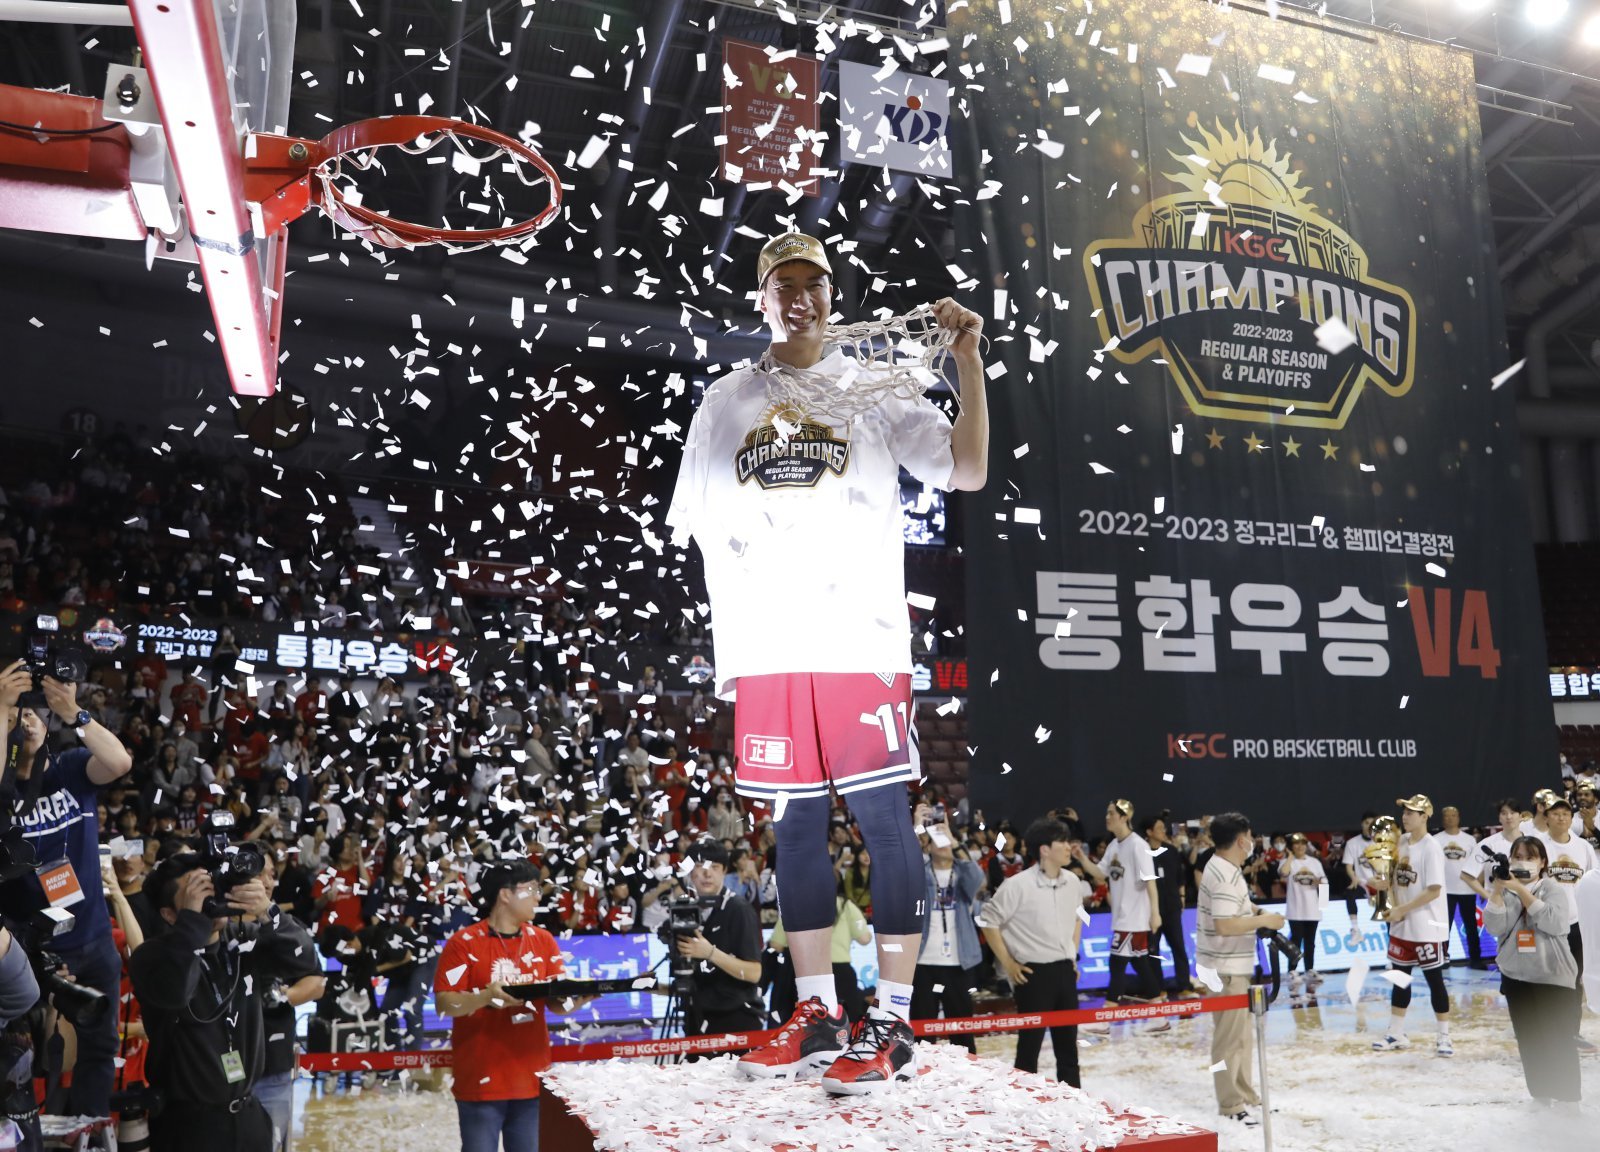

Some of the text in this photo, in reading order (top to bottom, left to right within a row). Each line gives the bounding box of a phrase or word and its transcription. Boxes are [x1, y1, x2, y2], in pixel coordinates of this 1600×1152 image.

[752, 99, 791, 111] 2011-212
[731, 125, 811, 147] REGUR SEASN
[880, 104, 951, 151] KB
[1224, 230, 1290, 262] KGC
[1104, 259, 1401, 376] CHAMPIONS
[1232, 322, 1294, 343] 2022-2023
[1200, 339, 1328, 370] REGULAR SEASON
[1222, 363, 1312, 389] & PLAYOFFS
[738, 442, 846, 481] CHAMPIONS
[1078, 508, 1455, 558] 2022-2023 정규리그 & 챔피언결정전
[138, 623, 218, 642] 2022-2023
[1035, 570, 1502, 679] 통합우승 V4
[276, 634, 408, 674] 통합우승
[935, 660, 968, 689] V4
[1167, 733, 1417, 759] KGC PRO BASKETBALL CLUB
[45, 870, 71, 886] MEDIA
[915, 899, 925, 916] 11
[1415, 943, 1437, 962] 22
[945, 1015, 1041, 1031] KC인삼공사프로농구단
